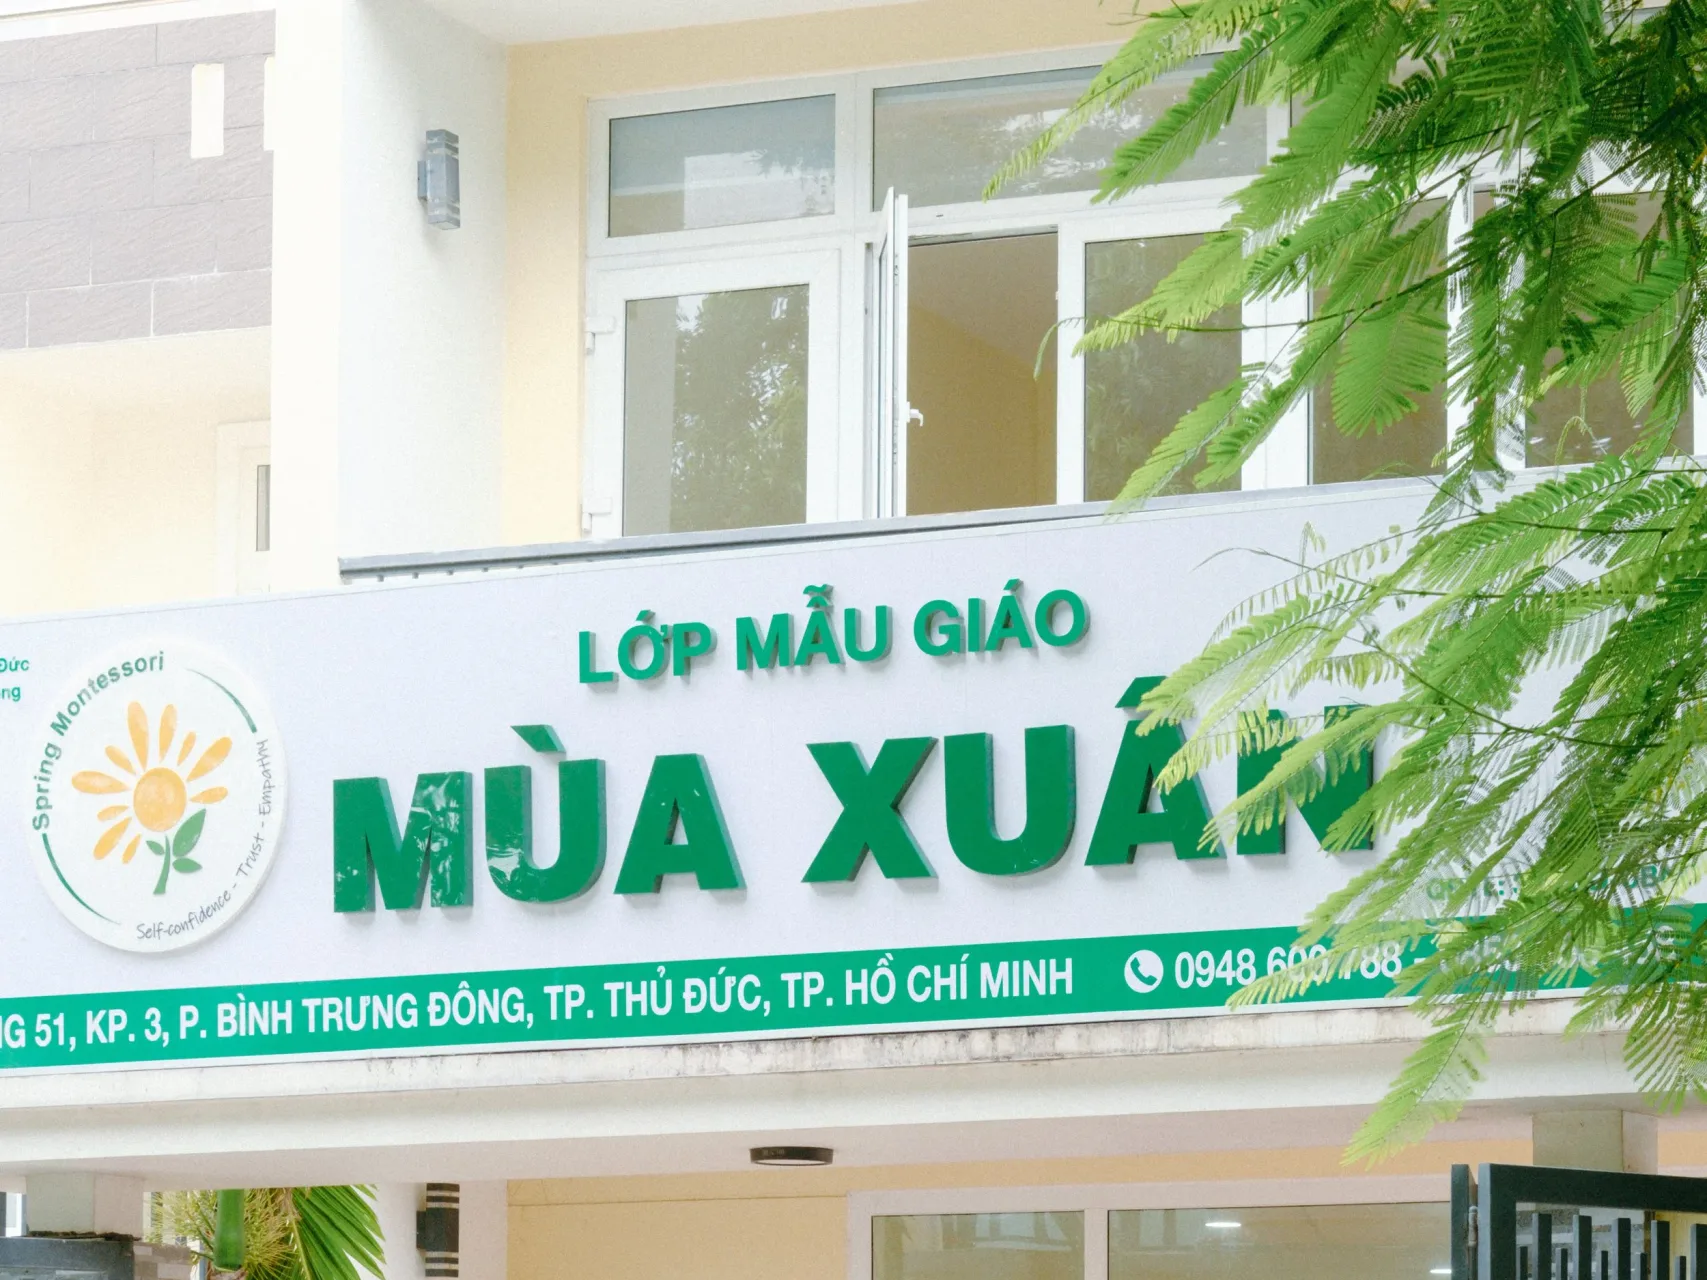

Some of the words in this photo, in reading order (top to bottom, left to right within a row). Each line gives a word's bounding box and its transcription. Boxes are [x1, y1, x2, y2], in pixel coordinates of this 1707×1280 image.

[578, 610, 715, 685] LỚP
[735, 584, 891, 671] MẪU
[912, 579, 1086, 657] GIÁO
[32, 742, 62, 831] Spring
[50, 651, 164, 736] Montessori
[333, 725, 746, 913] MÙA
[136, 891, 231, 939] Self-confidence
[235, 834, 264, 877] Trust
[256, 738, 276, 816] Empathy
[0, 1013, 26, 1048] G
[34, 1013, 76, 1052] 51,
[86, 1008, 135, 1044] KP.
[144, 1007, 169, 1048] 3,
[180, 1001, 205, 1038] P.
[217, 993, 292, 1037] BÌNH
[302, 993, 418, 1032] TRƯNG
[427, 981, 534, 1030] ĐÔNG,
[544, 983, 593, 1021] TP.
[604, 965, 670, 1018] THỦ
[682, 967, 772, 1017] ĐỨC,
[781, 970, 832, 1009] TP.
[845, 952, 896, 1006] HỒ
[907, 953, 968, 1003] CHÍ
[980, 957, 1074, 1000] MINH
[1174, 948, 1256, 988] 0948
